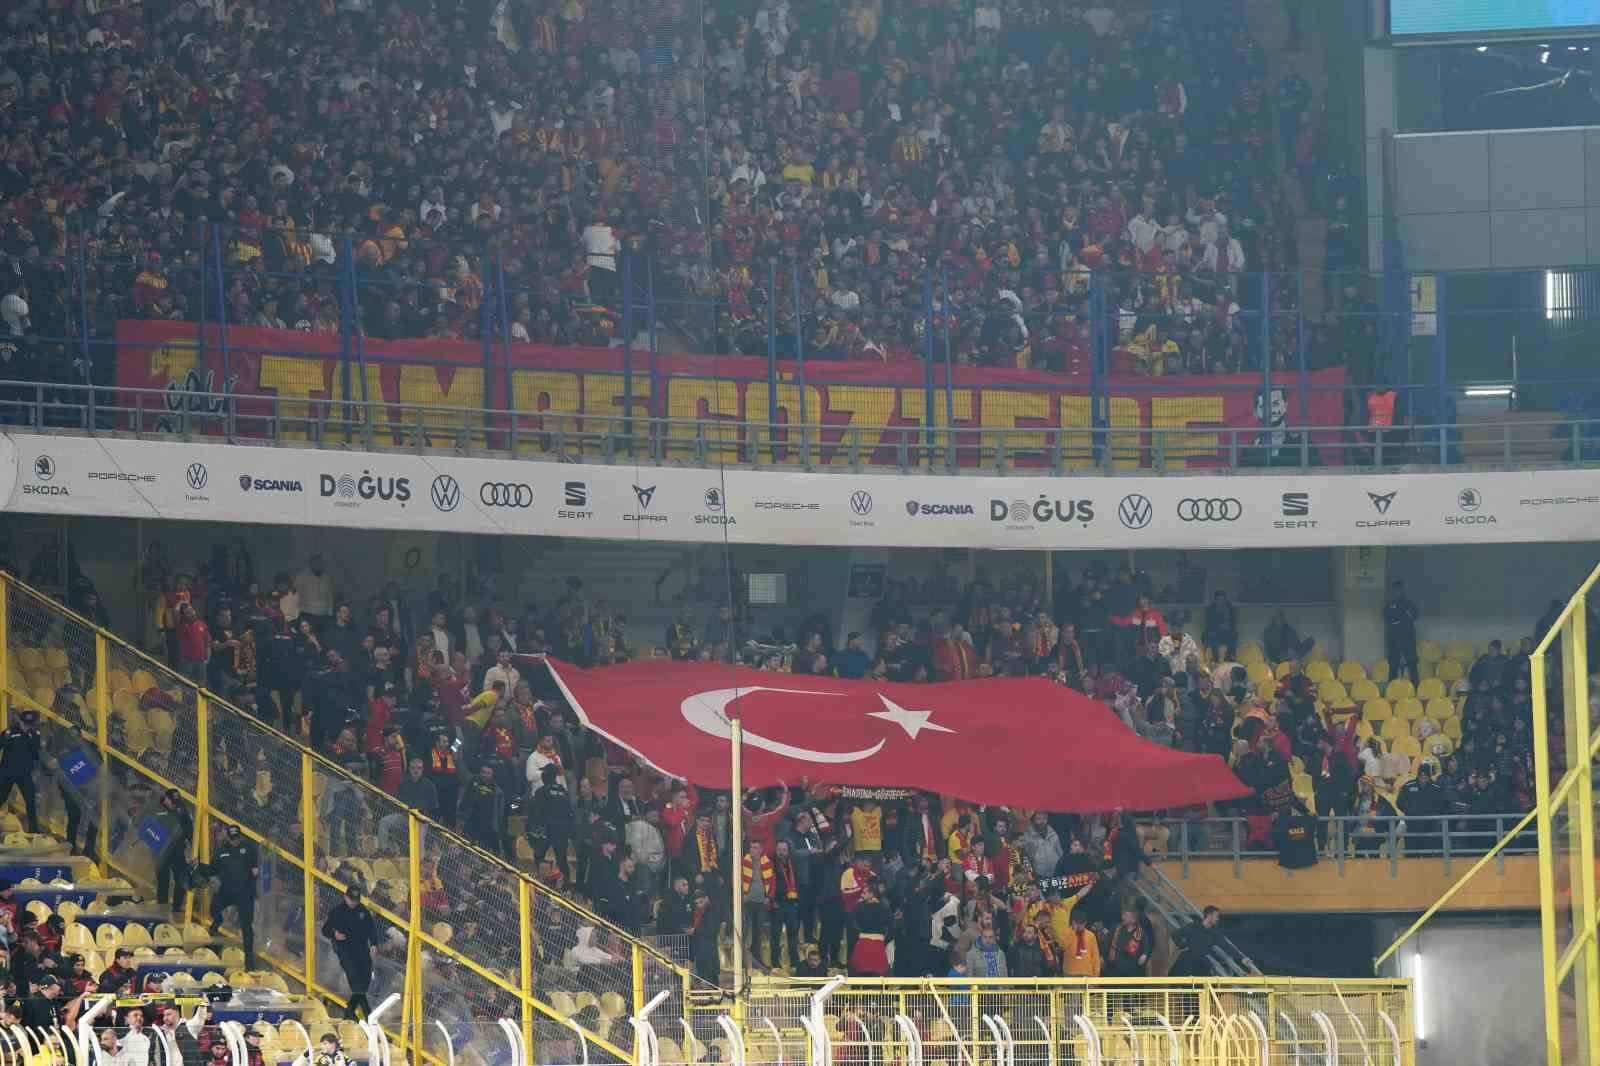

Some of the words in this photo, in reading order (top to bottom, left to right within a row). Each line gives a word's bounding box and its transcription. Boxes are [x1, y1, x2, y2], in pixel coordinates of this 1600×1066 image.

[88, 472, 158, 482] PORSCHE
[253, 479, 303, 492] SCANIA
[754, 502, 821, 511] PORSCHE
[921, 504, 974, 515] SCANIA
[558, 510, 593, 520] SEAT
[623, 514, 668, 522] CUPRA
[1273, 520, 1319, 528] SEAT
[1355, 519, 1411, 528] CUPRA
